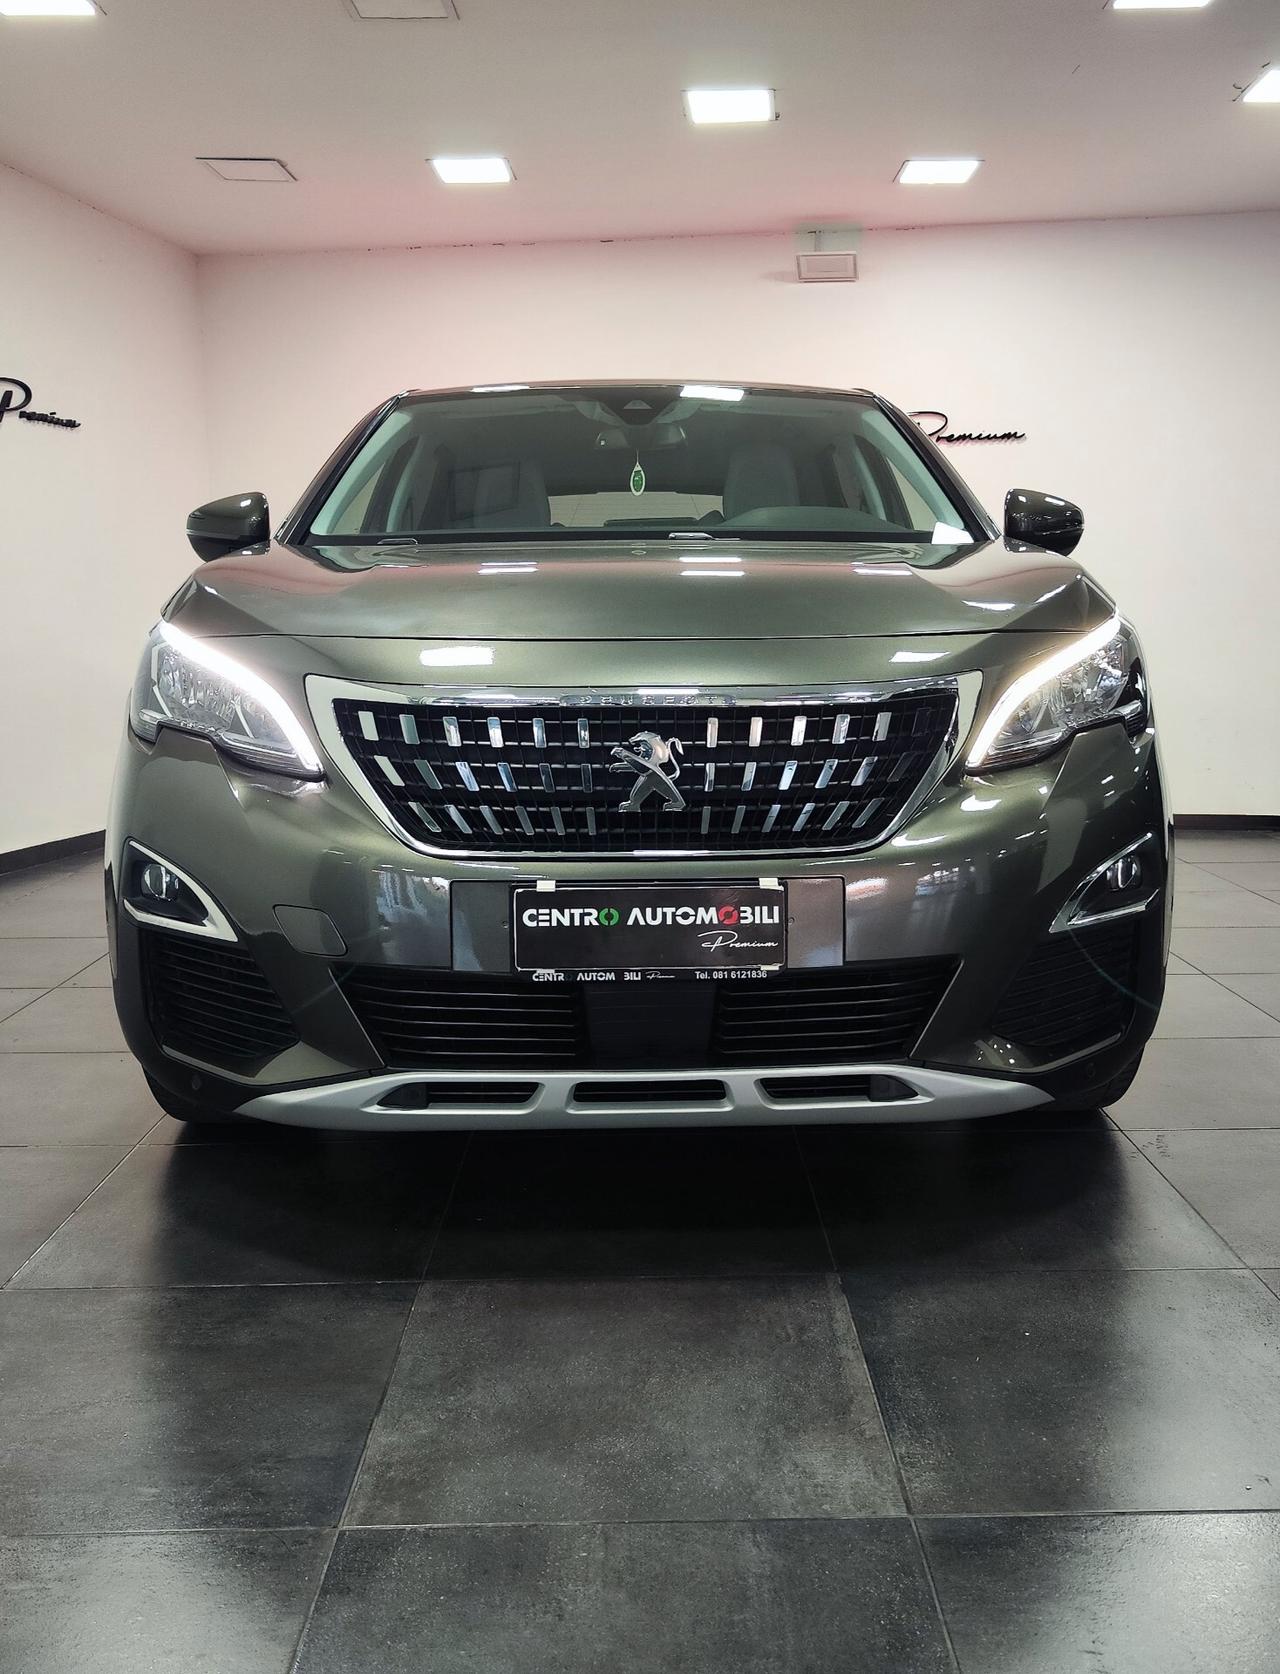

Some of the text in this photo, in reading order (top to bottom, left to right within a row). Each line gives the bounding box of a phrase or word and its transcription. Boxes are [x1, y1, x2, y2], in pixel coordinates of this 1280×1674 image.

[522, 905, 780, 927] CENTRO AUTOMOBILI
[698, 930, 779, 952] Premium
[532, 972, 572, 982] CENTR
[694, 969, 768, 980] Tel. 081 6121836
